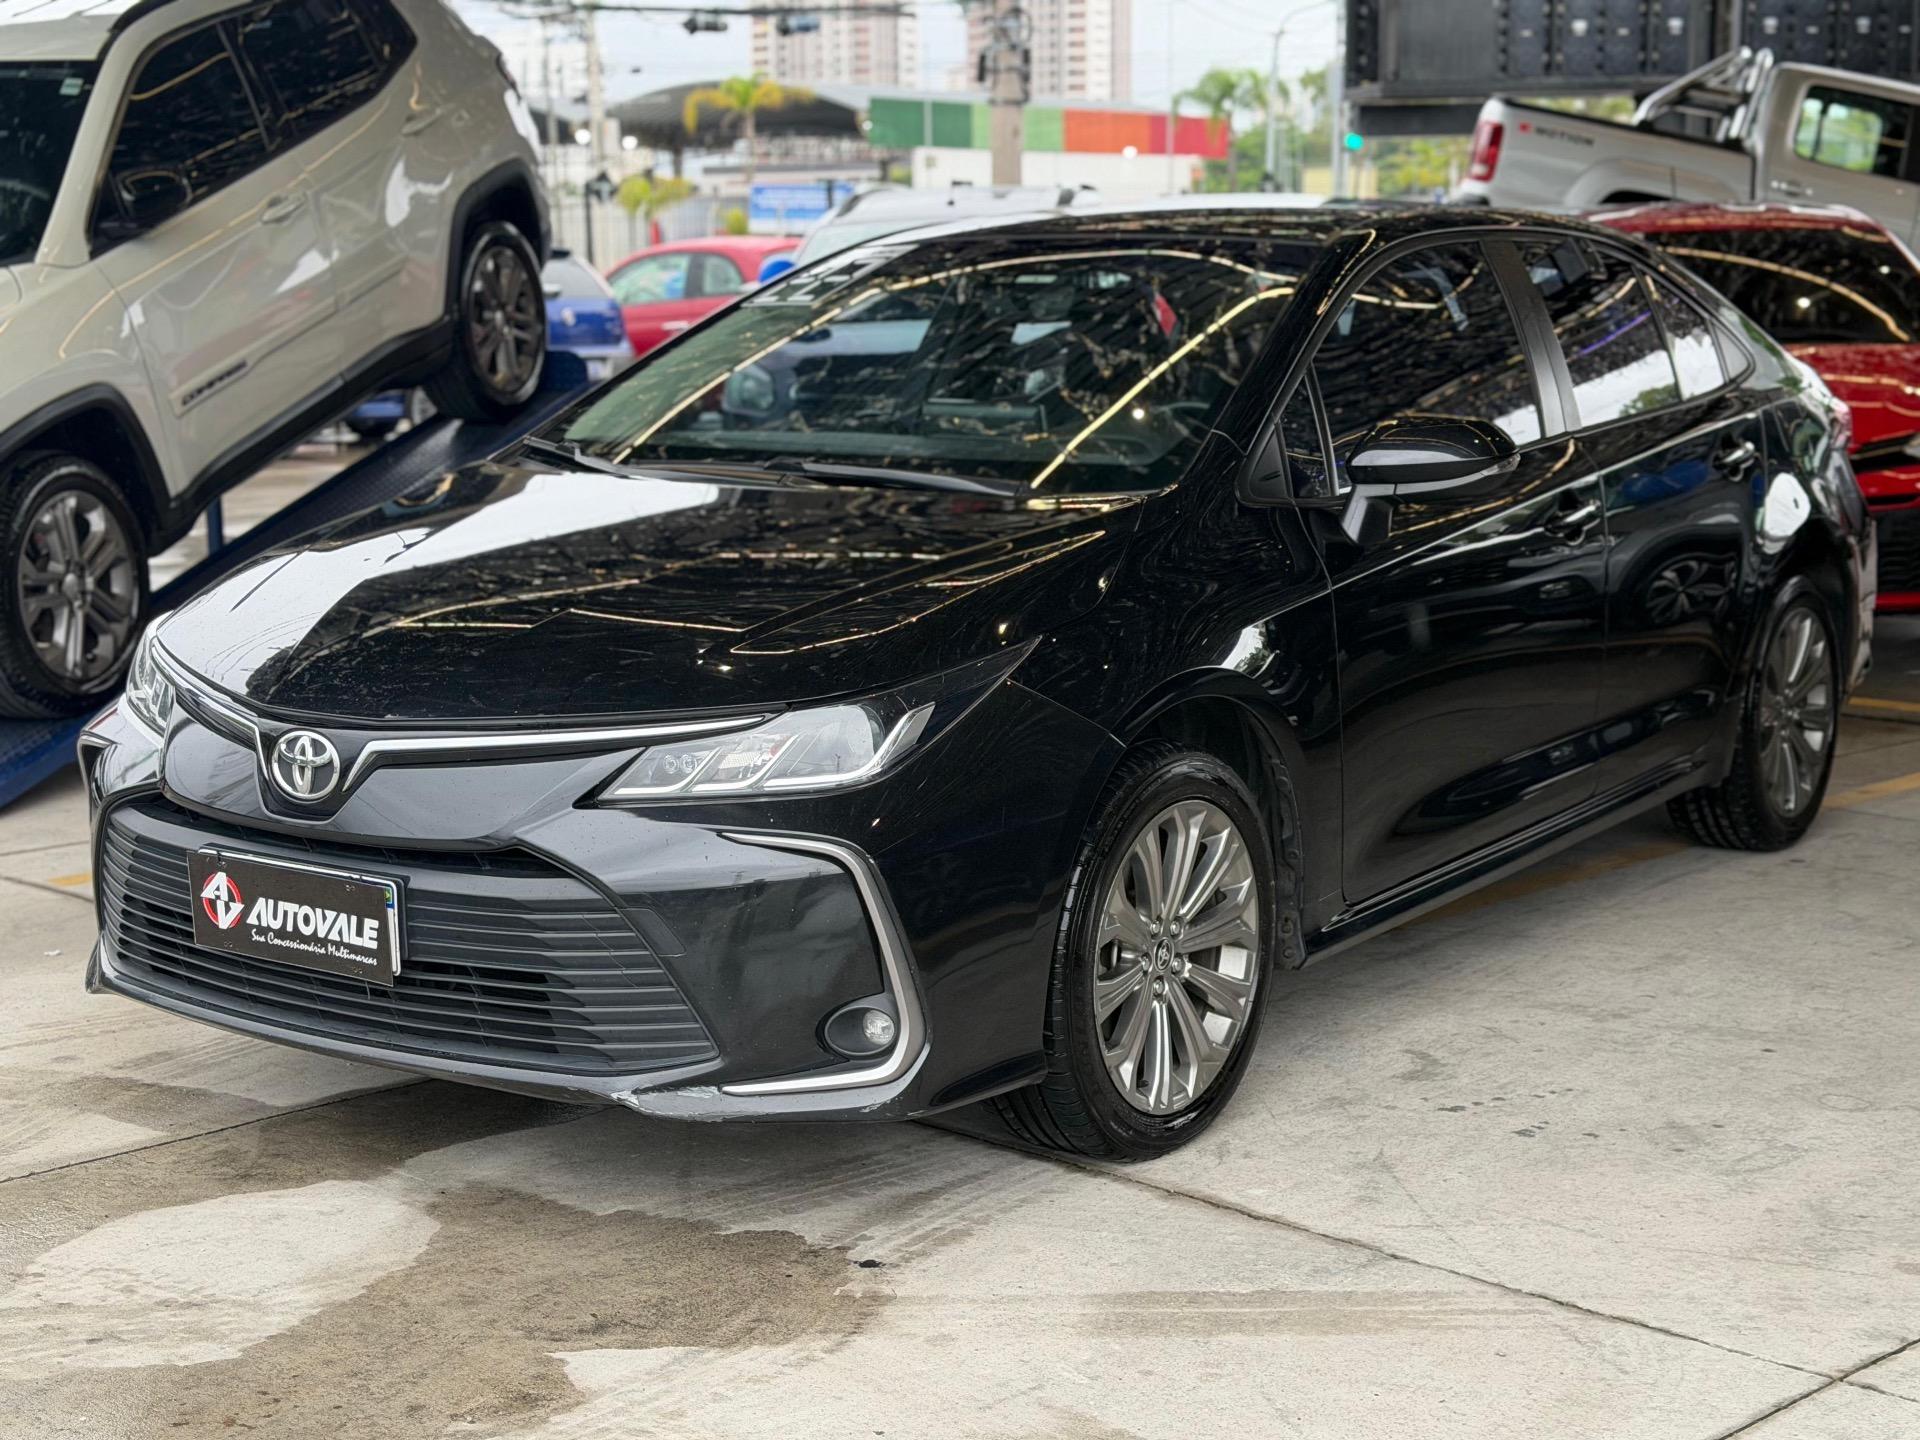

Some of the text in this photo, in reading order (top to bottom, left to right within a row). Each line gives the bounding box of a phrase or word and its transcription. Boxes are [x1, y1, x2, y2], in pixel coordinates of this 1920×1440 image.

[246, 897, 379, 949] AUTOVALE
[251, 928, 266, 943] Sua
[327, 943, 378, 966] Multimarcas
